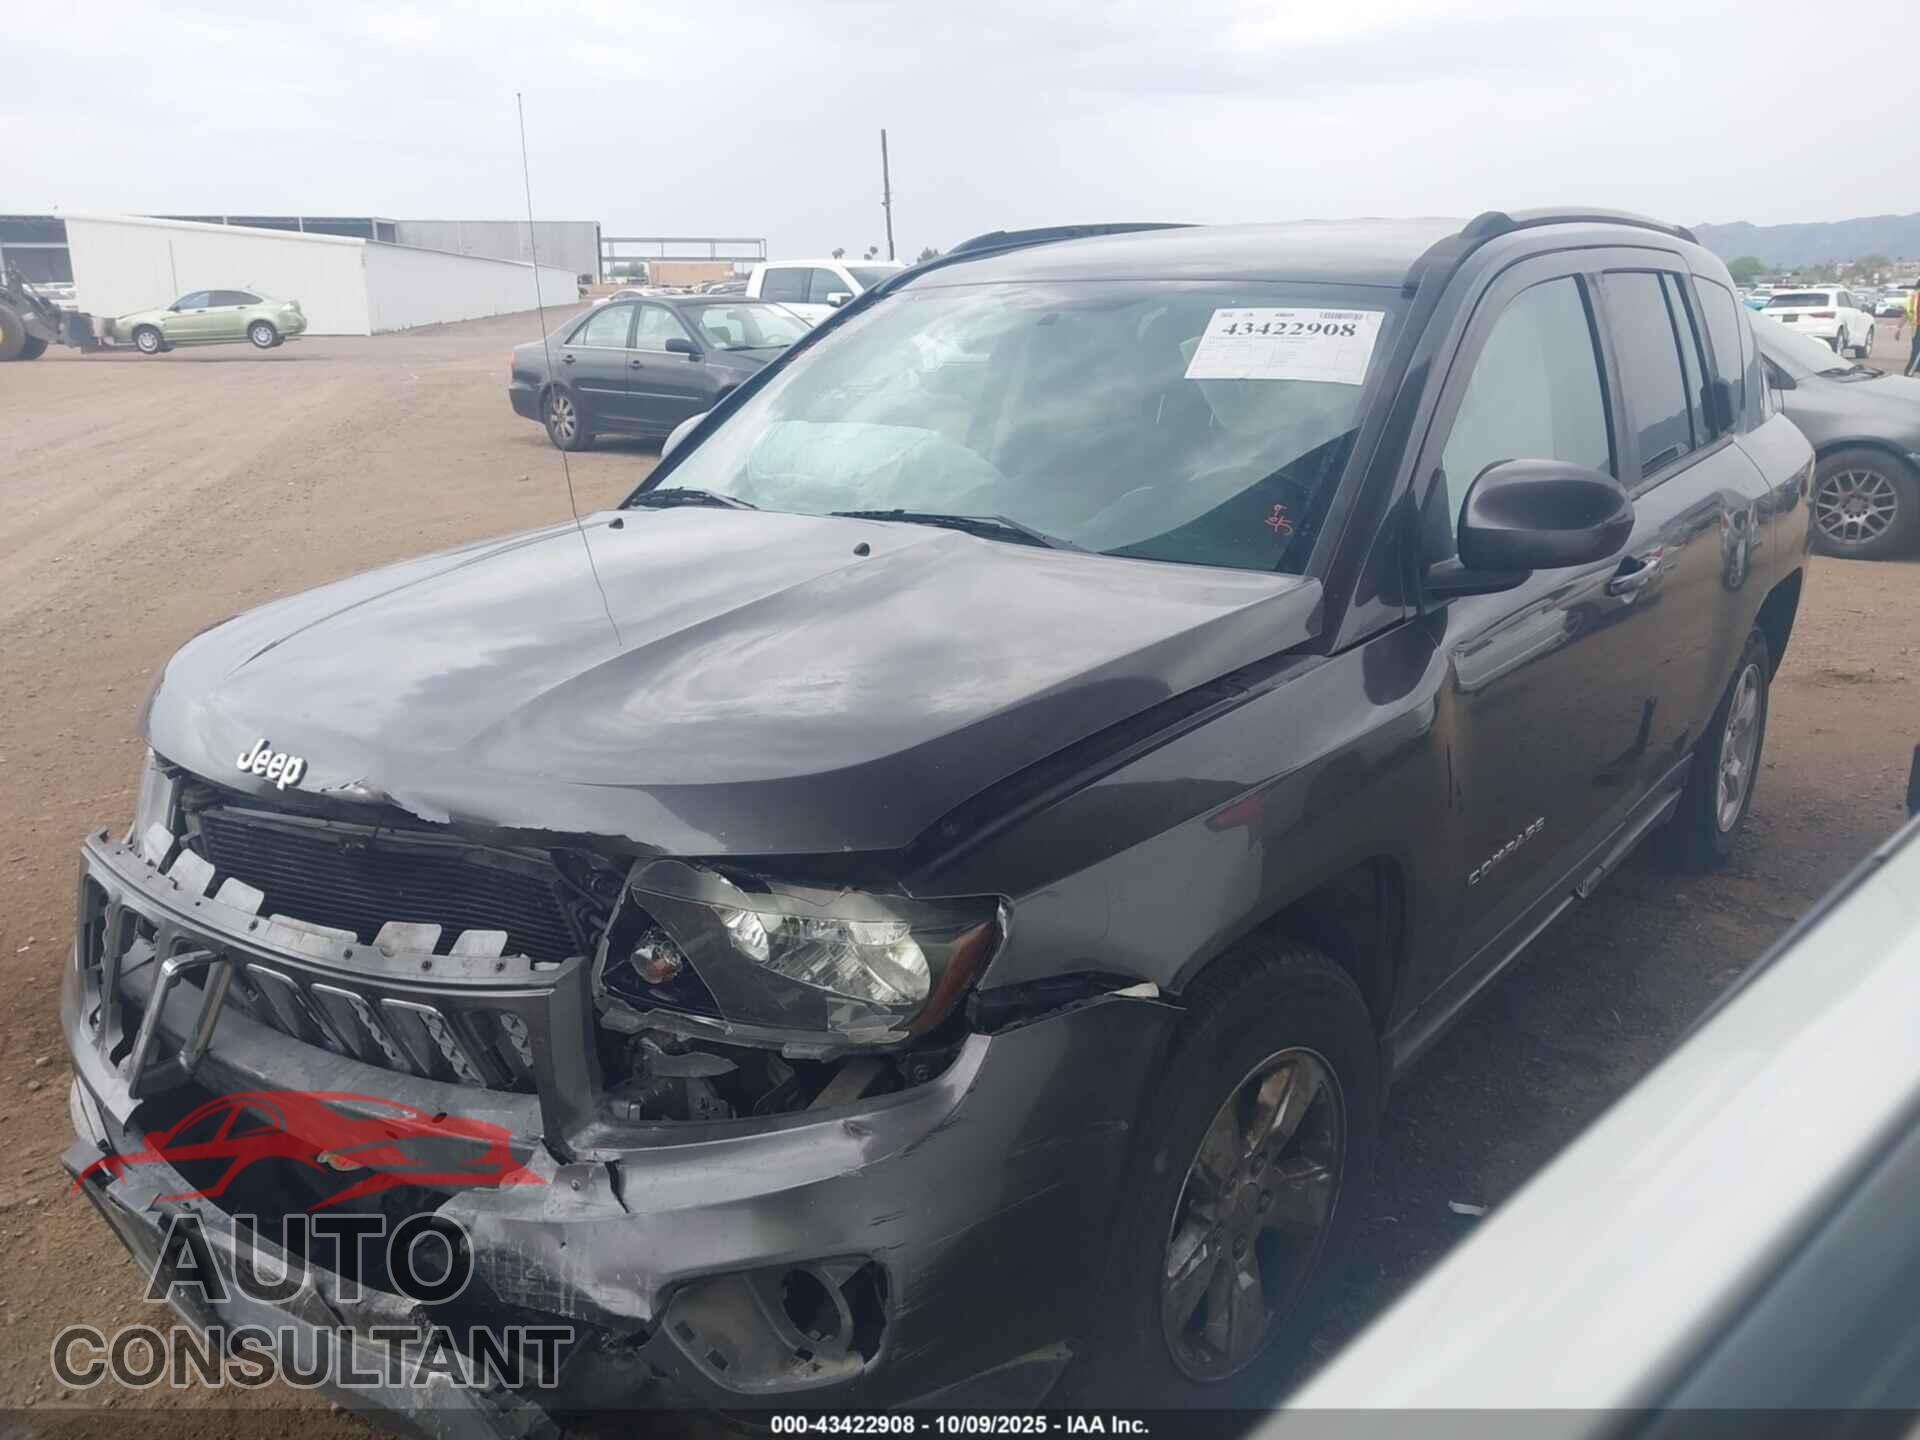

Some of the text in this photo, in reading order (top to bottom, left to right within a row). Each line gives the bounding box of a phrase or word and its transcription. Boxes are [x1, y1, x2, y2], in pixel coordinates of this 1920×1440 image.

[1221, 322, 1356, 337] 43422908
[236, 738, 306, 790] Jeep
[1468, 817, 1544, 887] COMPASS
